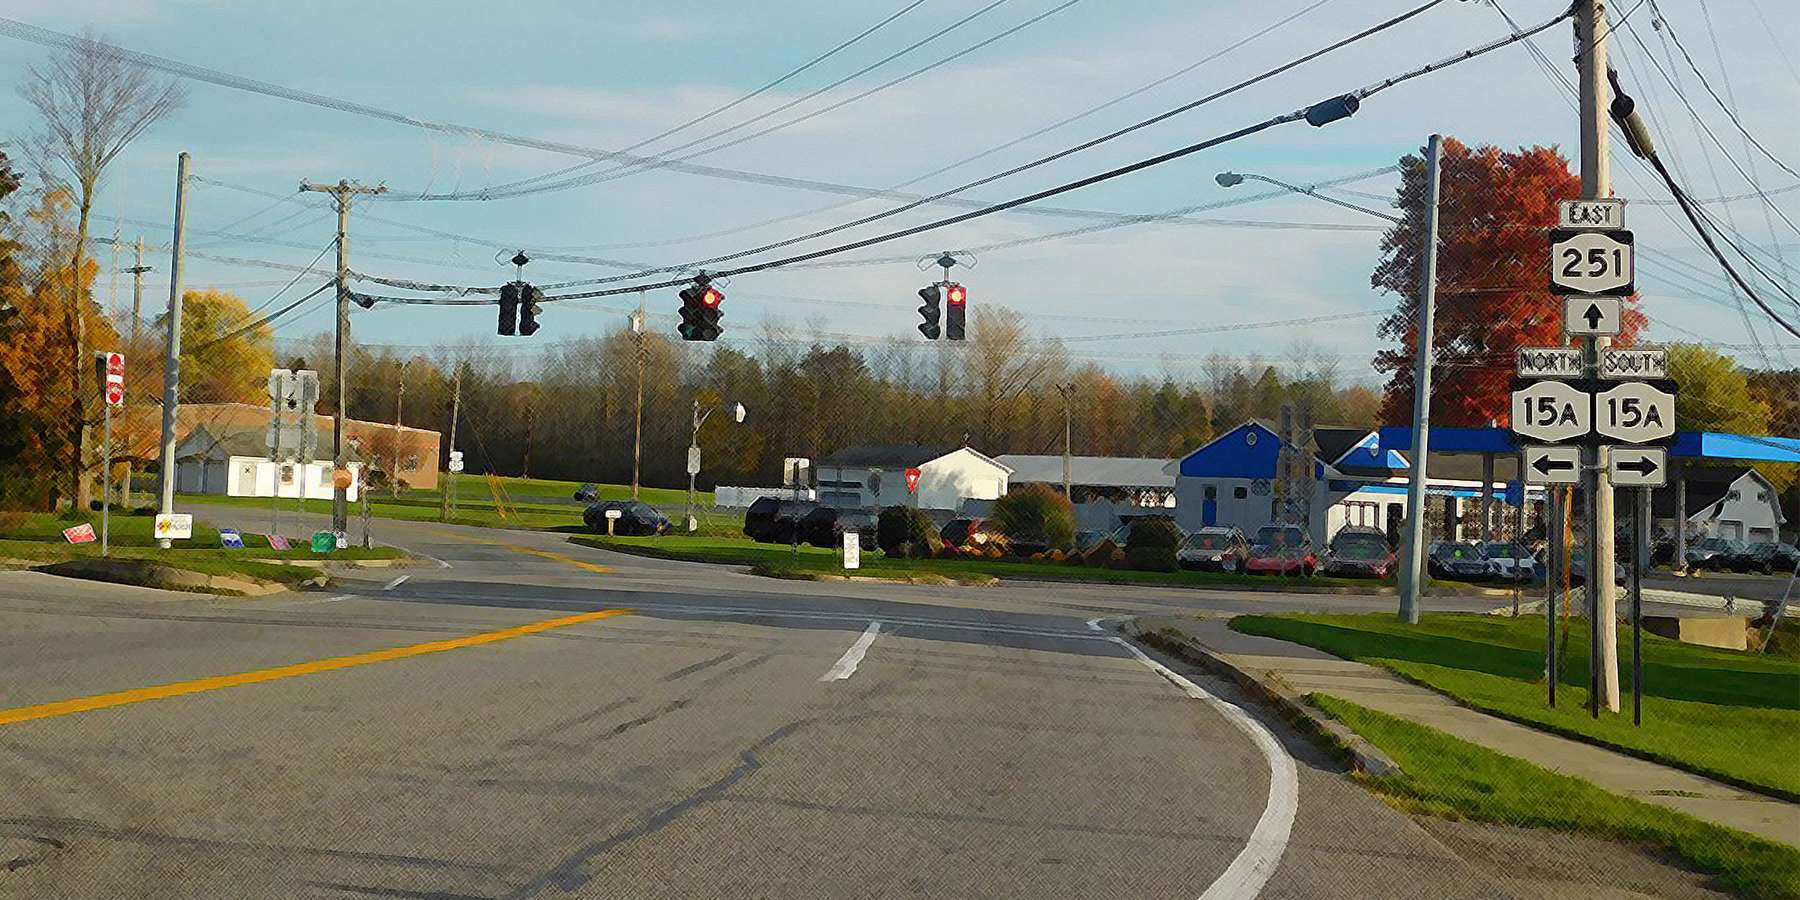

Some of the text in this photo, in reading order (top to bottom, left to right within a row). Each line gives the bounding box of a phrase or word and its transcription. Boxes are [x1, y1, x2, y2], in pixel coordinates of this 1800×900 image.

[1569, 203, 1612, 225] EAST
[1562, 248, 1621, 278] 251
[1520, 353, 1582, 371] NORTH
[1605, 352, 1666, 373] SOUTH
[1524, 397, 1578, 427] 15A
[1608, 398, 1663, 428] 15A
